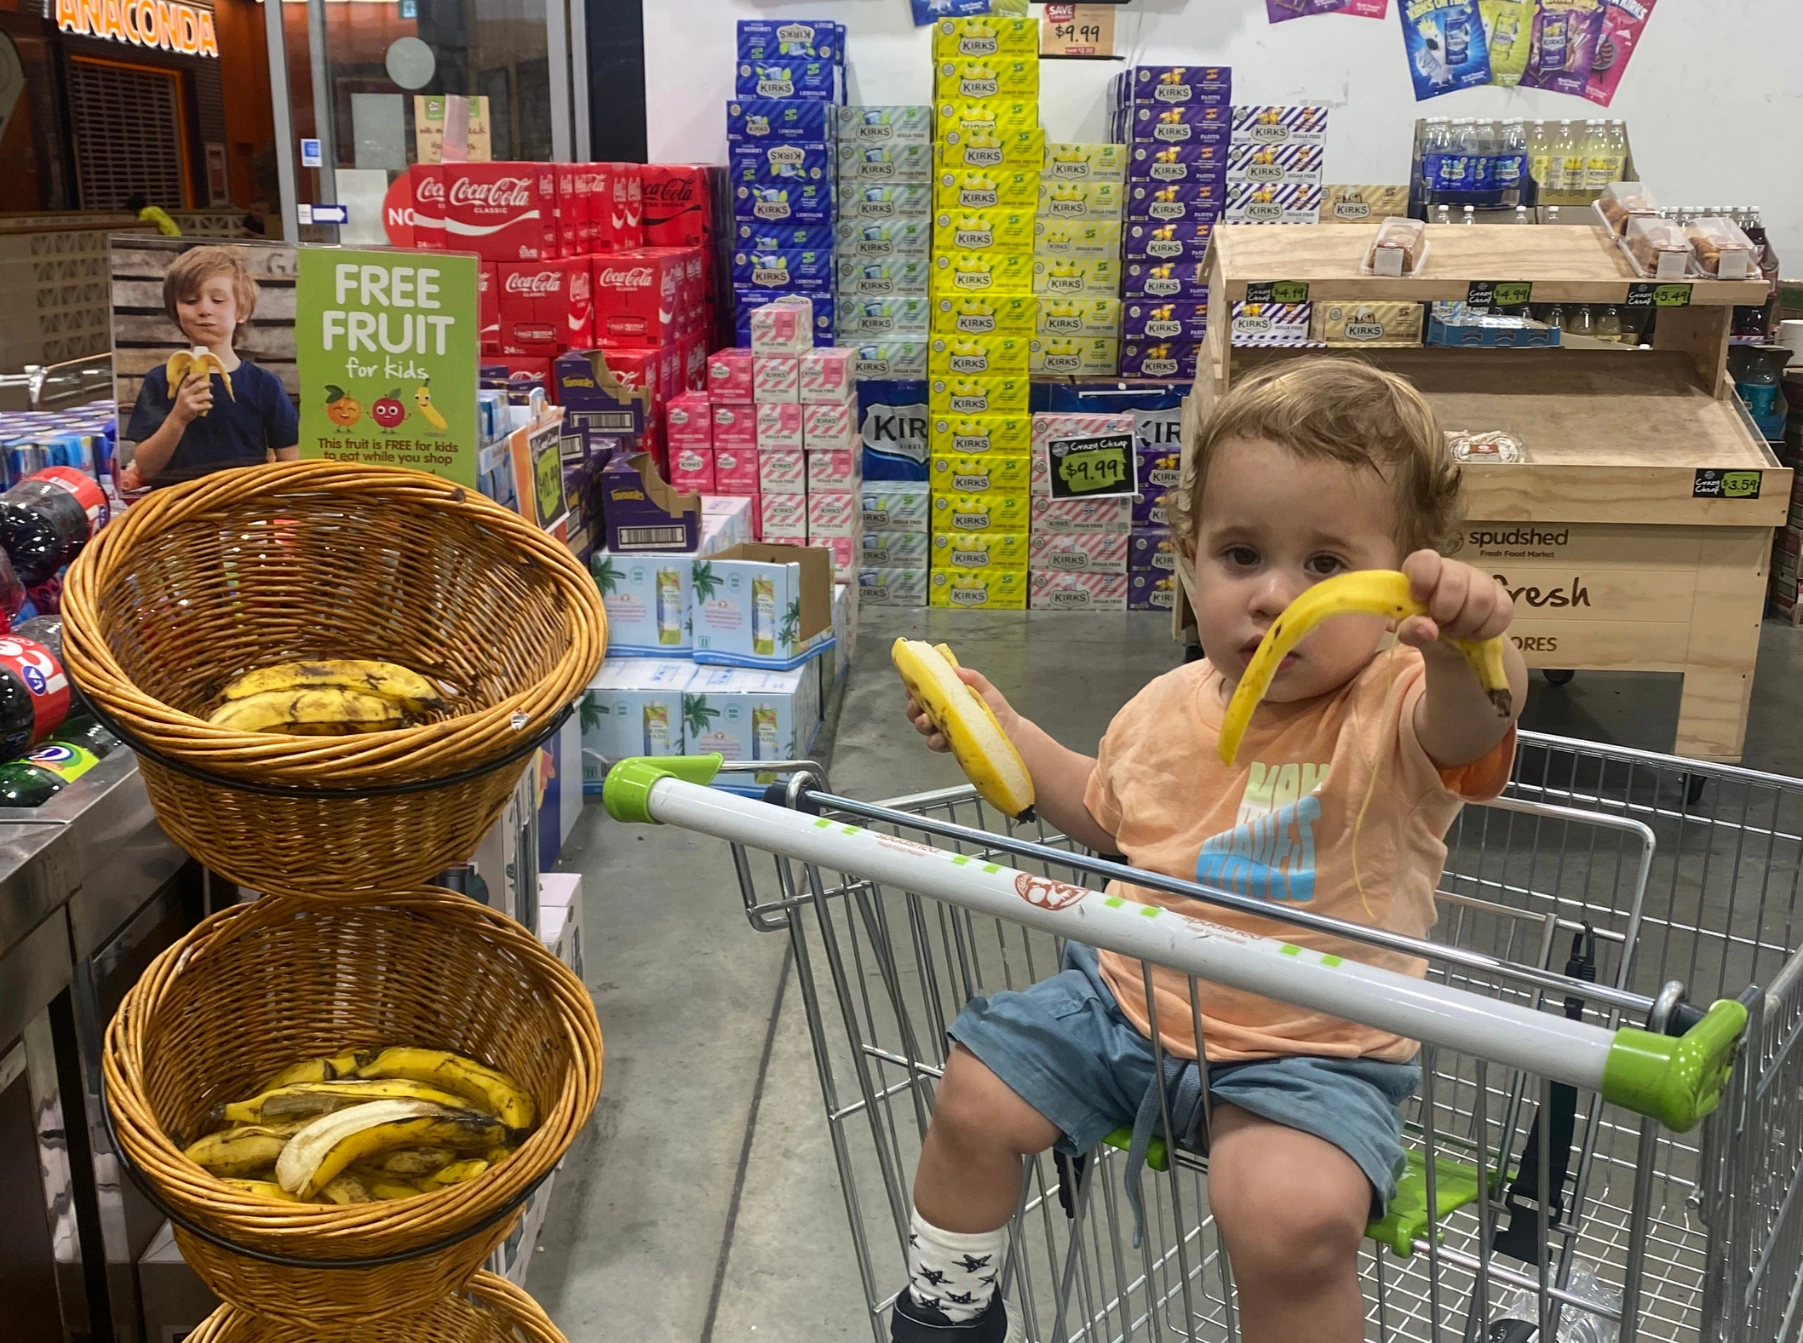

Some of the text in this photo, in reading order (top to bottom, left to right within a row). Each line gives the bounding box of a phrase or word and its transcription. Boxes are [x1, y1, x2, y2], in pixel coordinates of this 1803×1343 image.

[1049, 5, 1073, 15] SAVE
[1618, 0, 1648, 20] KIRKS
[56, 0, 219, 57] ANACONDA
[1055, 24, 1100, 42] $9.99
[780, 30, 811, 39] KIRKS
[963, 42, 995, 50] KIRKS
[760, 84, 791, 93] KIRKS
[963, 83, 995, 92] KIRKS
[1158, 88, 1189, 97] KIRKS
[860, 128, 890, 136] KIRKS
[1158, 128, 1188, 136] KIRKS
[1256, 128, 1286, 136] KIRKS
[770, 151, 801, 160] KIRKS
[968, 152, 1000, 160] KIRKS
[1056, 165, 1086, 173] KIRKS
[1154, 167, 1184, 175] KIRKS
[1251, 168, 1280, 176] KIRKS
[450, 177, 534, 206] Coca-Cola
[642, 178, 695, 200] oca-Cola
[963, 194, 995, 202] KIRKS
[757, 205, 788, 214] KIRKS
[862, 205, 891, 213] KIRKS
[1153, 206, 1182, 214] KIRKS
[1337, 206, 1367, 214] KIRKS
[958, 235, 990, 243] KIRKS
[860, 244, 890, 252] KIRKS
[1150, 244, 1180, 252] KIRKS
[600, 267, 654, 287] Coca-Cola
[756, 272, 787, 281] KIRKS
[957, 276, 989, 284] KIRKS
[336, 264, 440, 308] FREE
[506, 272, 562, 292] Coca-Cola
[860, 282, 890, 290] KIRKS
[1495, 290, 1527, 300] $4.99
[1655, 292, 1687, 301] $5.49
[960, 319, 992, 327] KIRKS
[1238, 320, 1268, 328] KIRKS
[322, 310, 454, 355] FRUIT
[1349, 327, 1381, 335] KIRKS
[345, 356, 430, 379] for kids
[856, 363, 886, 371] KIRKS
[953, 360, 986, 368] KIRKS
[874, 415, 929, 441] KIR
[1139, 420, 1181, 447] KIR
[318, 438, 458, 452] This fruit is FREE for kids
[956, 440, 988, 448] KIRKS
[1070, 440, 1128, 452] Crazy Cheap
[324, 451, 452, 465] to eat while you shop
[1066, 460, 1117, 480] $9.99
[956, 479, 987, 487] KIRKS
[1696, 479, 1720, 488] Crazy
[1723, 480, 1757, 490] $3.59
[956, 517, 987, 525] KIRKS
[1469, 528, 1568, 548] spudshed
[1053, 556, 1085, 564] KIRKS
[1236, 762, 1330, 828] MA
[1199, 796, 1322, 875] WAVES
